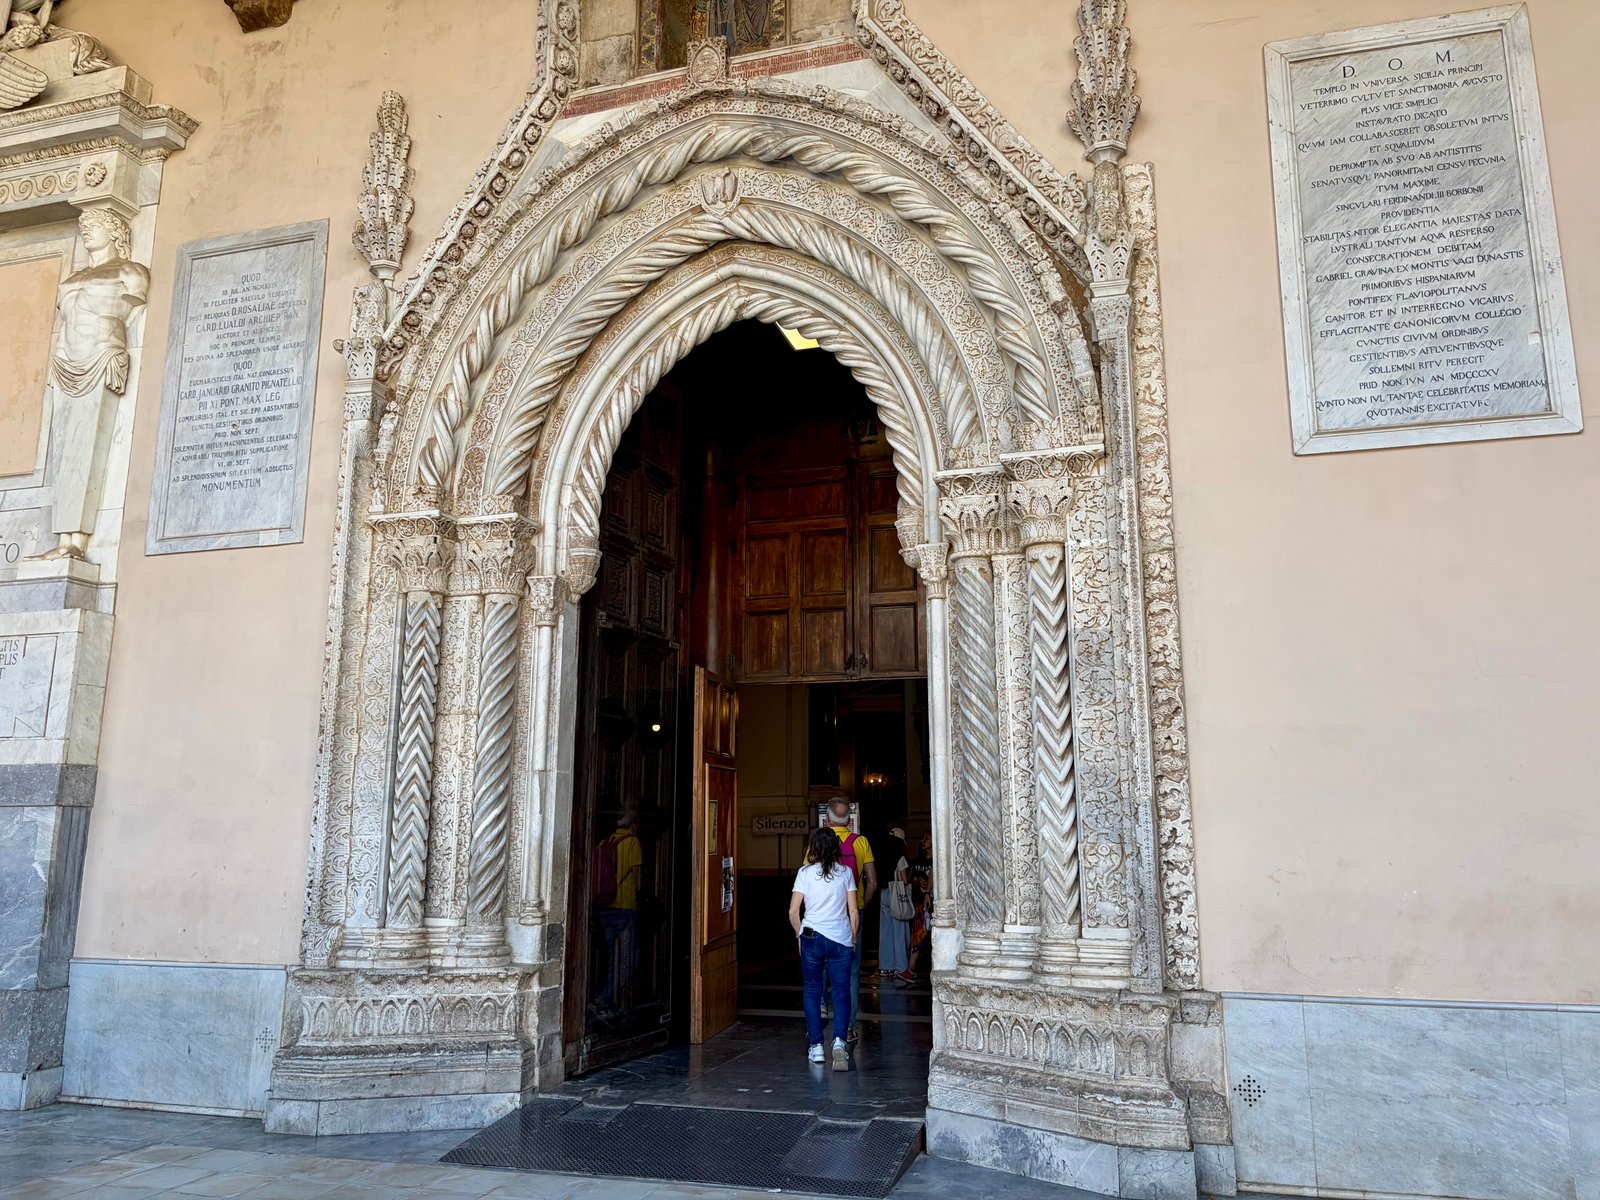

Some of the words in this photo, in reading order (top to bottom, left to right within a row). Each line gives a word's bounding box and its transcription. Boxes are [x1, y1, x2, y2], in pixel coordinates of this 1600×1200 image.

[1342, 65, 1357, 78] D.
[1388, 57, 1405, 71] O.
[1435, 50, 1455, 64] M.
[1313, 85, 1346, 96] TEMPLO
[1364, 75, 1409, 88] VNIVERSA
[1447, 64, 1483, 76] PRINCIPI
[1300, 97, 1348, 111] VETERRIMO
[1351, 92, 1382, 103] CVLTV
[1384, 90, 1396, 98] ET
[1398, 81, 1458, 96] SANCTIMONIA
[1461, 74, 1503, 87] AVGVSTO
[1361, 106, 1380, 115] PLVS
[1383, 102, 1403, 111] VICE
[1406, 97, 1438, 108] SIMPLICI
[1355, 114, 1411, 128] INSTAVRATO
[1414, 109, 1448, 120] DICATO
[1330, 137, 1346, 145] IAM
[1350, 126, 1421, 143] COLLABASCERET
[1424, 118, 1478, 132] OBSOLETVM
[1481, 114, 1509, 124] INTVS
[1329, 159, 1379, 172] DEPROMPTA
[1381, 157, 1393, 165] AB
[1396, 154, 1415, 163] SVO
[1419, 152, 1431, 160] AB
[1433, 144, 1483, 158] ANTISTITIS
[1369, 145, 1382, 153] ET
[1374, 165, 1434, 179] PANORMITANI
[1437, 160, 1466, 171] CENSV
[1468, 155, 1506, 166] PECVNIA
[1376, 183, 1399, 193] TVM
[1403, 178, 1440, 189] MAXIME
[1336, 199, 1381, 212] SINGVLARI
[1381, 205, 1440, 219] PROVIDENTIA
[1353, 227, 1380, 237] NITOR
[1383, 219, 1438, 233] ELEGANTIA
[1495, 208, 1521, 218] DATA
[1331, 241, 1373, 254] LVSTRALI
[1375, 236, 1416, 248] TANTVM
[1420, 232, 1446, 244] AQVA
[1449, 226, 1495, 238] RESPERSO
[1346, 248, 1431, 265] CONSECRATIONEM
[1437, 241, 1482, 254] DEBITAM
[1316, 271, 1352, 282] GABRIEL
[1355, 266, 1394, 278] GRAVINA
[1396, 264, 1408, 273] EX
[1411, 259, 1449, 271] MONTIS
[1453, 256, 1474, 266] VAGI
[1361, 278, 1412, 291] PRIMORIBVS
[1416, 271, 1476, 284] HISPANIARVM
[1325, 311, 1365, 323] CANTOR
[1369, 309, 1383, 318] ET
[1388, 308, 1397, 316] IN
[1402, 300, 1465, 314] INTERREGNO
[1469, 294, 1514, 307] VICARIVS
[1349, 294, 1393, 306] PONTIFEX
[1394, 314, 1470, 329] CANONICORVM
[1475, 308, 1522, 320] COLLEGIO
[1357, 336, 1400, 348] CVNCTIS
[1403, 332, 1437, 343] CIVIVM
[1441, 326, 1489, 338] ORDINIBVS
[1349, 348, 1416, 362] GESTIENTIBVS
[233, 361, 253, 372] QUOD
[1369, 363, 1415, 375] SOLLEMNI
[1419, 360, 1442, 369] RITV
[1446, 356, 1485, 367] PEREGIT
[1359, 381, 1378, 390] PRID
[1406, 376, 1424, 385] IVN
[1430, 374, 1445, 383] AN
[1450, 368, 1500, 381] MDCCCXV
[1348, 397, 1367, 405] NON
[1370, 395, 1385, 403] IVL
[1387, 391, 1424, 402] TANTAE
[1427, 385, 1490, 398] CELEBRITATIS
[1367, 405, 1424, 420] QVOTANNIS
[201, 478, 261, 492] MONUMENTUM
[756, 817, 806, 830] Silenzio
